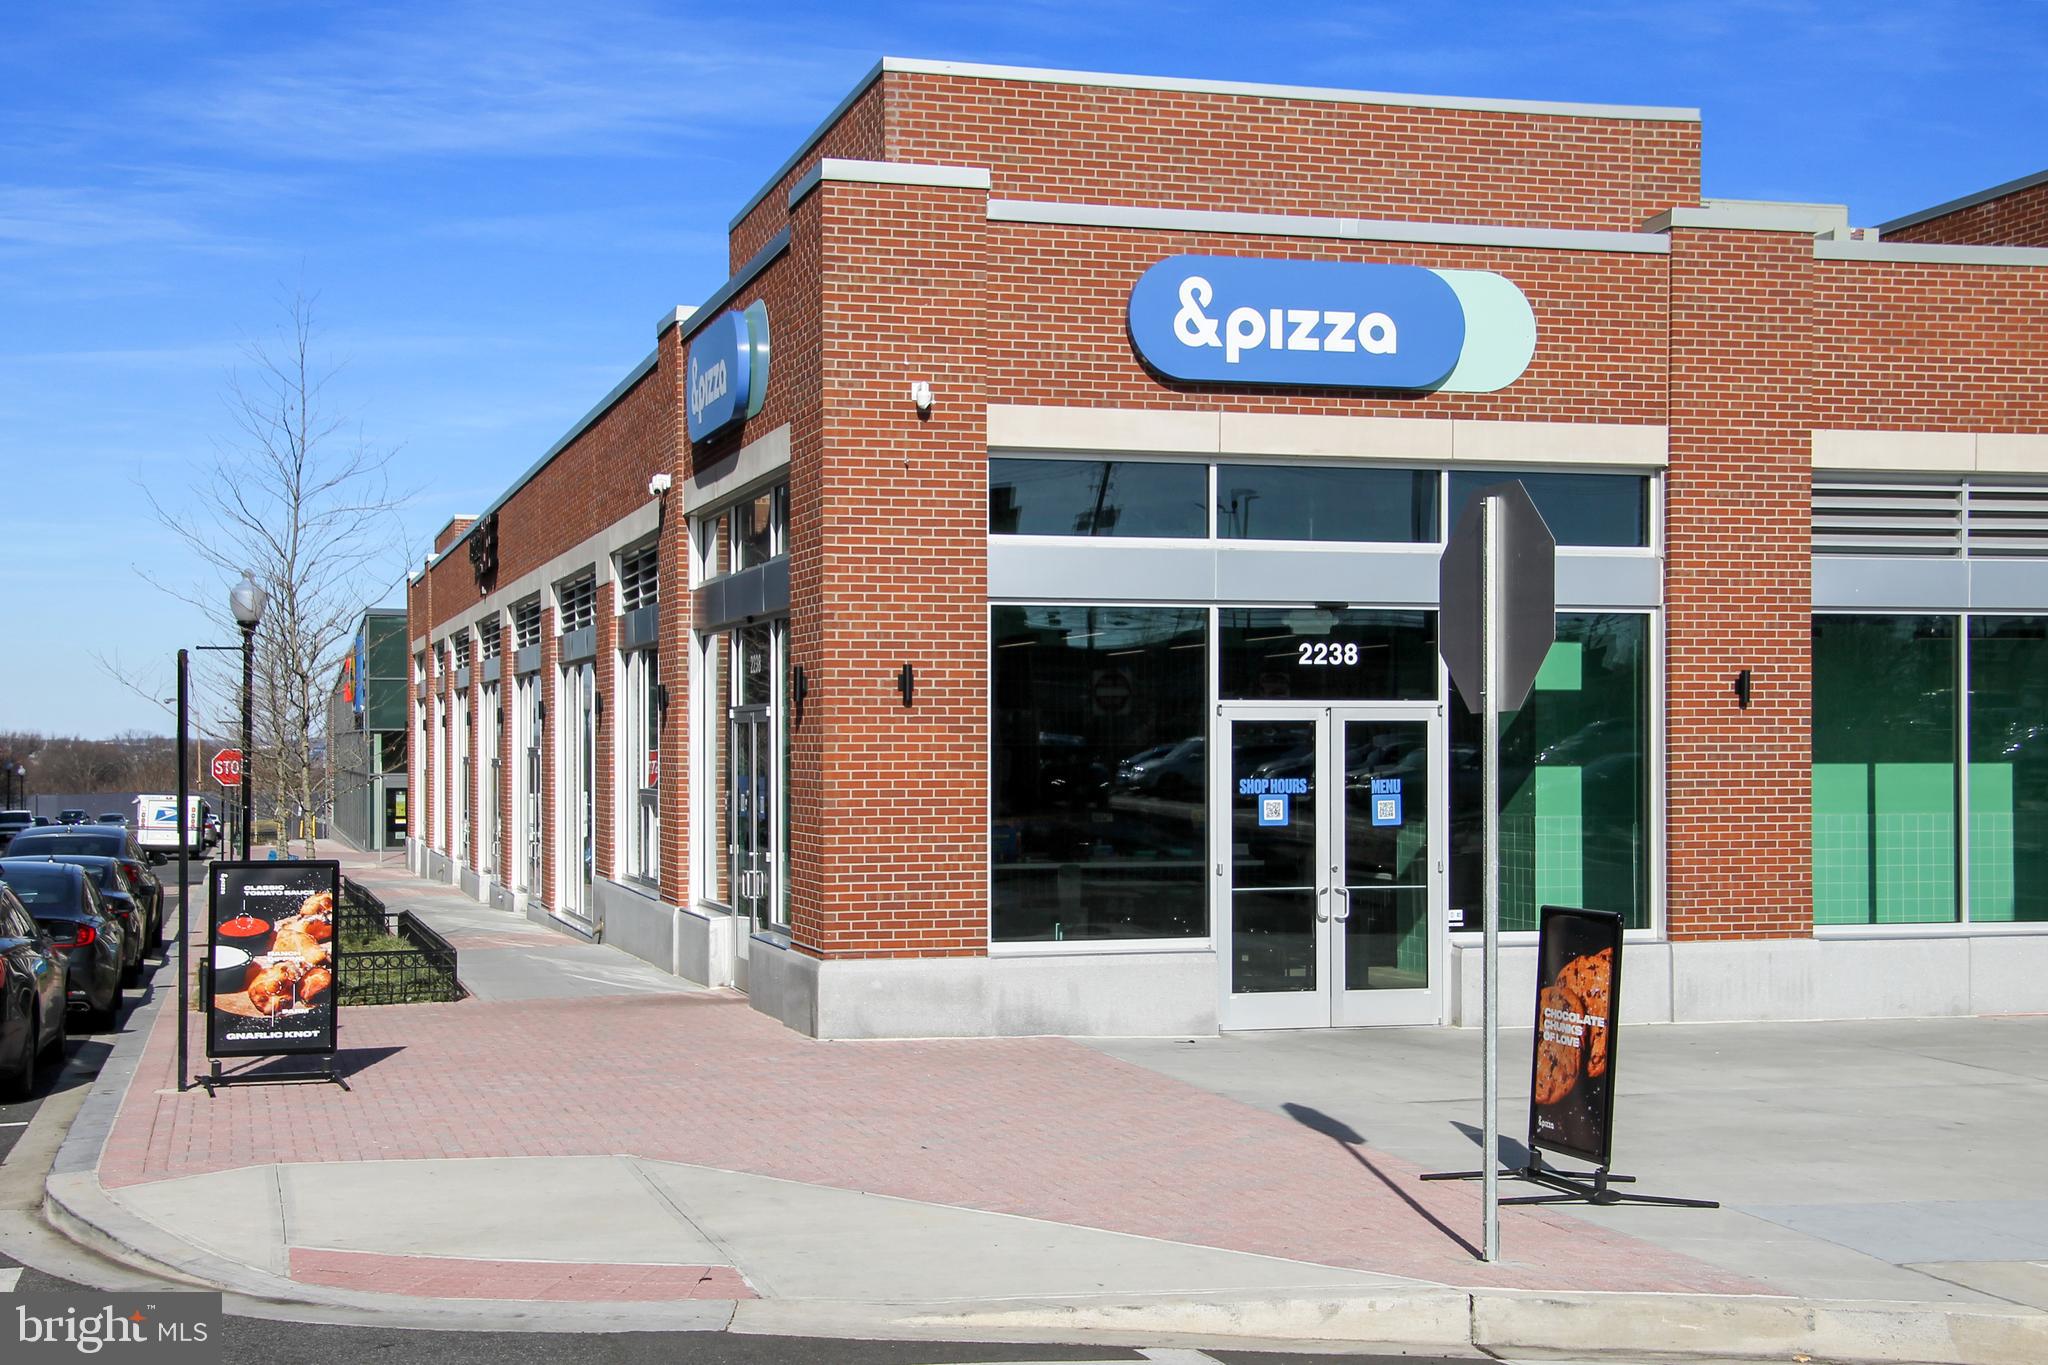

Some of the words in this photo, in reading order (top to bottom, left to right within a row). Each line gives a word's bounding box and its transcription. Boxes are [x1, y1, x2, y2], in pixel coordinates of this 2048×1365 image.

[1174, 276, 1397, 363] &pizza
[691, 357, 727, 424] &pizza
[1298, 643, 1358, 665] 2238
[215, 761, 243, 774] STO
[1239, 779, 1269, 794] SHOP
[1270, 778, 1307, 794] HOURS
[1371, 779, 1401, 794] MENU
[1544, 1008, 1605, 1028] CHOCOLATE
[226, 1030, 283, 1040] GNARLIC
[284, 1030, 320, 1039] KNOT
[1543, 1019, 1583, 1036] CHUNKS
[1543, 1031, 1556, 1042] OF
[1555, 1033, 1580, 1048] LOVE
